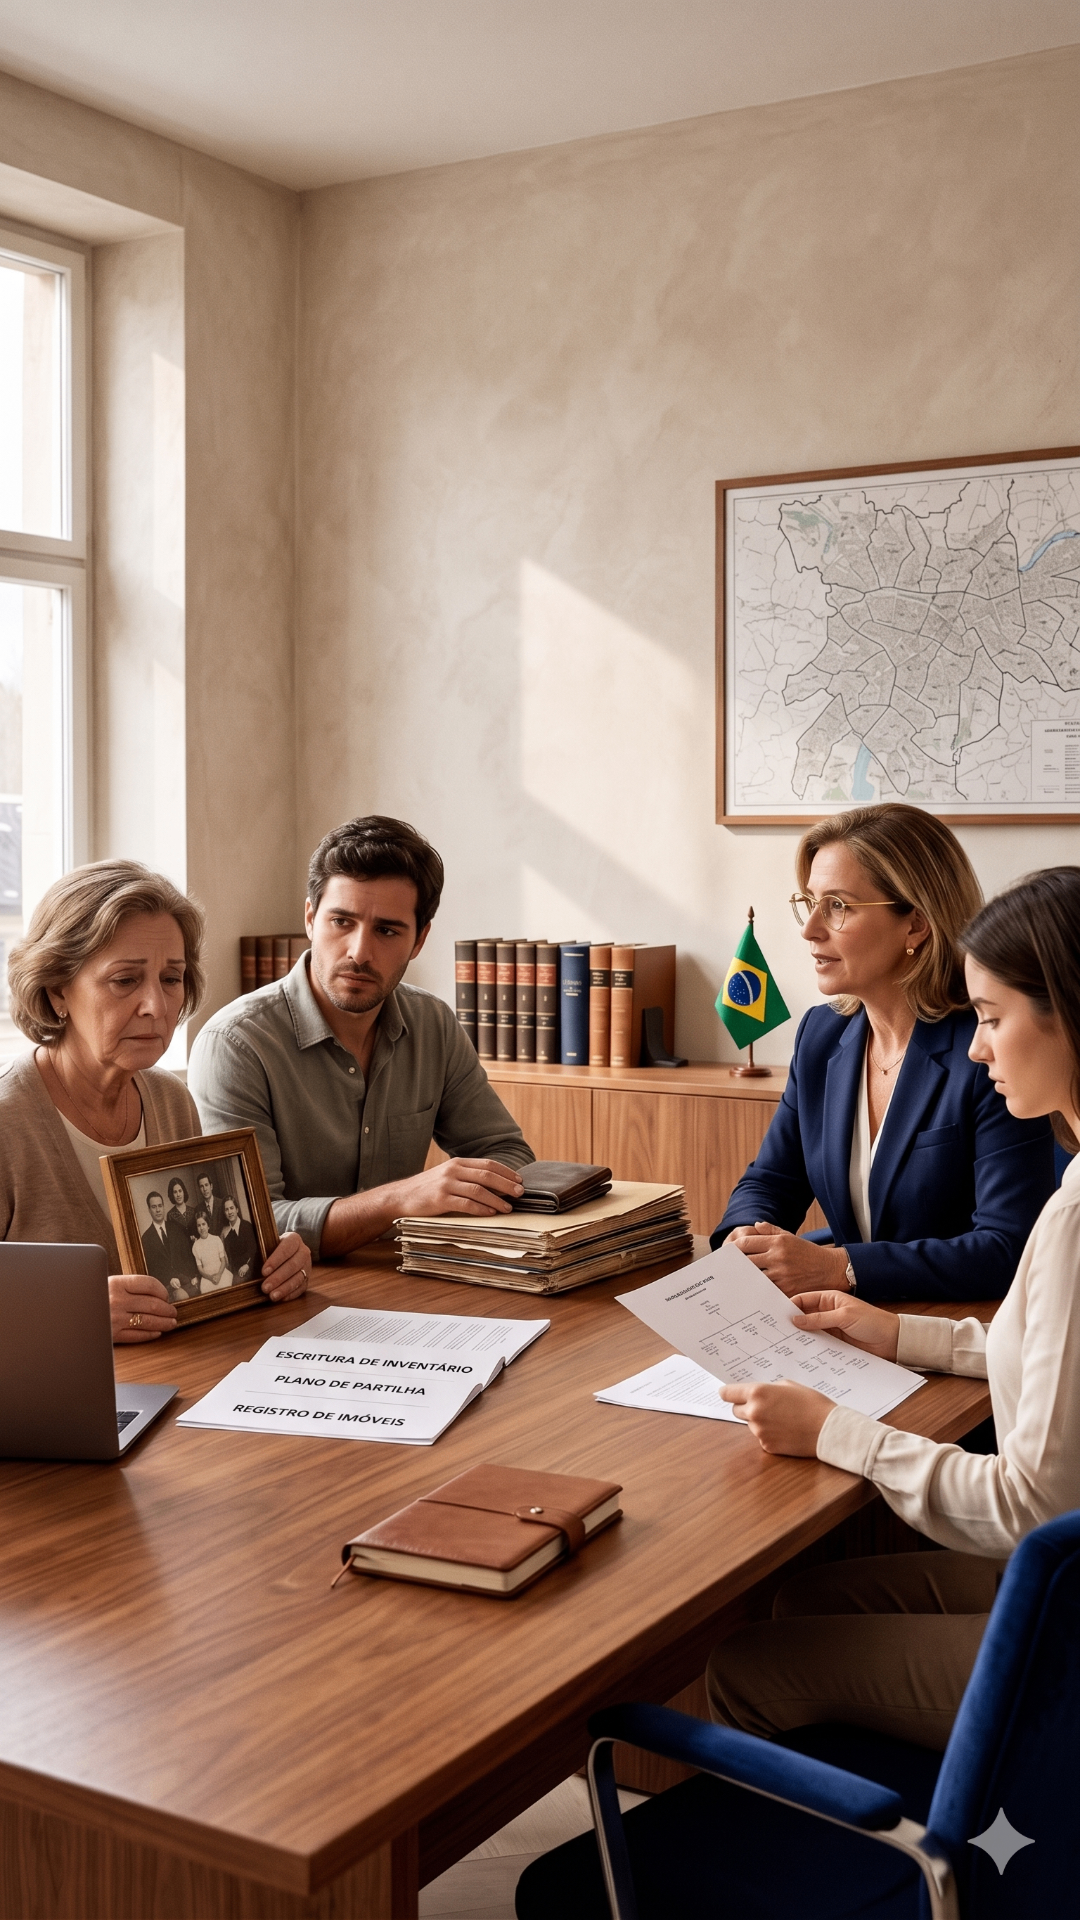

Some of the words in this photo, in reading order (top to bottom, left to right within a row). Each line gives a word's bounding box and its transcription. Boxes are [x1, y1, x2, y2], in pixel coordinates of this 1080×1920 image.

[275, 1351, 355, 1365] ESCRITURA
[358, 1357, 381, 1366] DE
[382, 1359, 473, 1374] INVENTÁRIO
[274, 1375, 327, 1387] PLANO
[328, 1380, 351, 1389] DE
[352, 1382, 425, 1396] PARTILHA
[232, 1404, 310, 1418] REGISTRO
[312, 1411, 336, 1420] DE
[337, 1413, 406, 1426] IMÓVEIS
